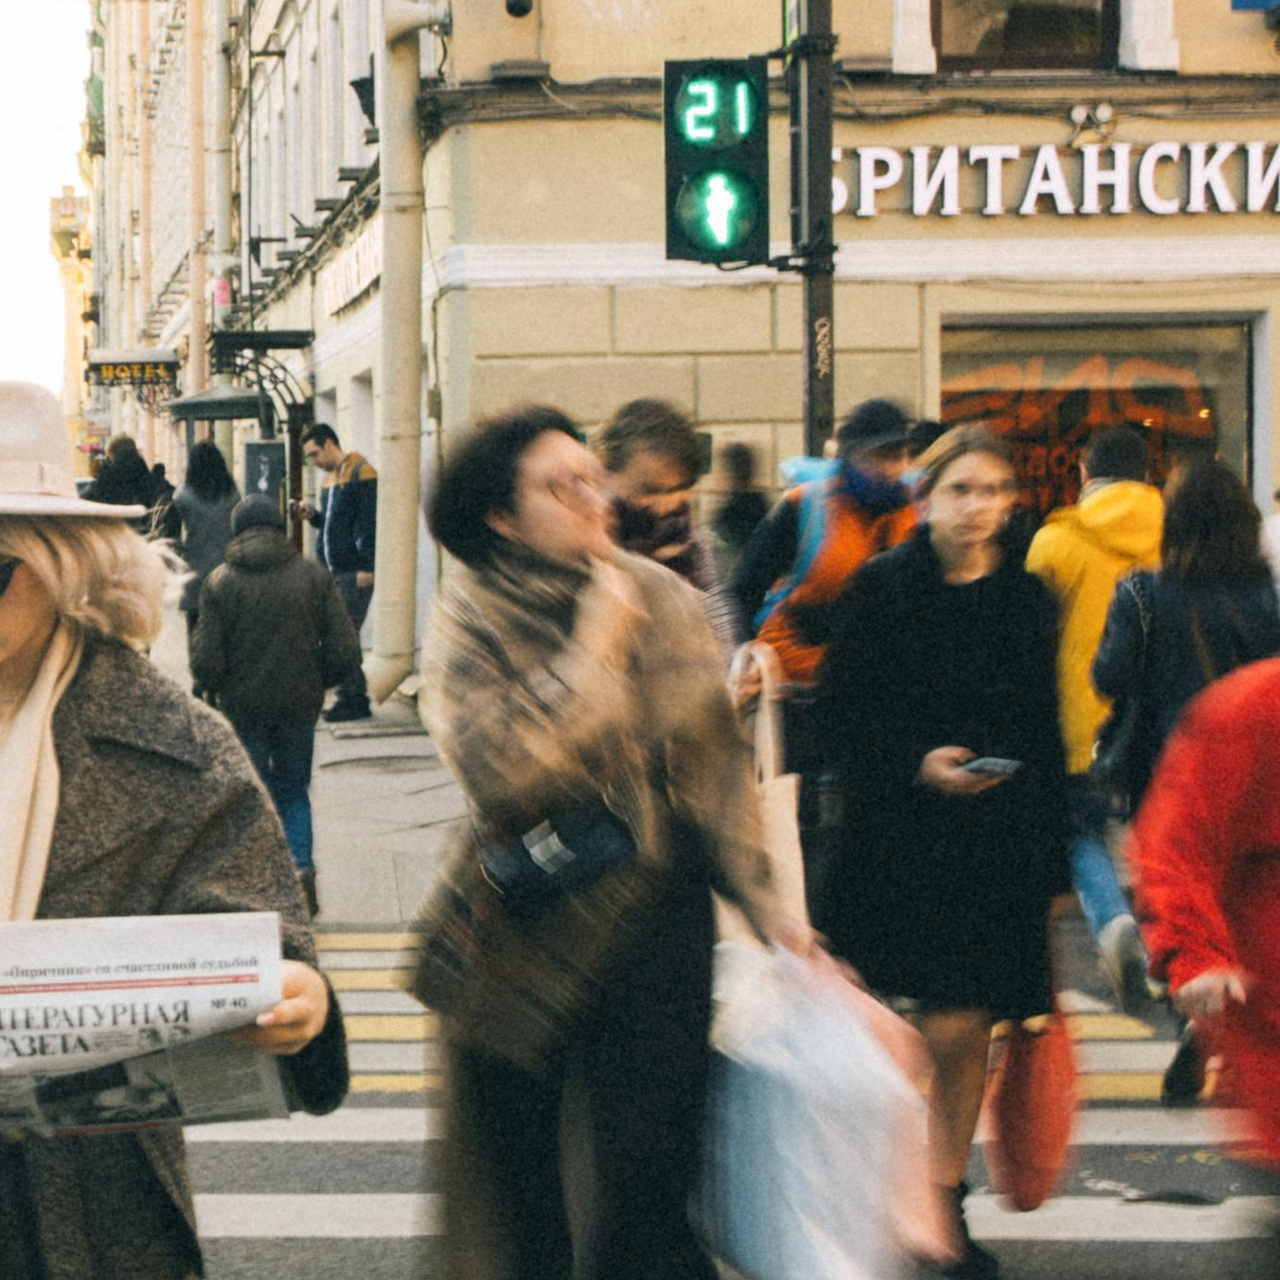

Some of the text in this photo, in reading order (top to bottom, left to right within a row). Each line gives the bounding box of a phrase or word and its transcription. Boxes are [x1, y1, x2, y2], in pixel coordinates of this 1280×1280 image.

[685, 79, 749, 140] 21
[101, 364, 172, 380] HOTEL
[113, 957, 197, 974] счастливой
[200, 955, 258, 972] судьбой
